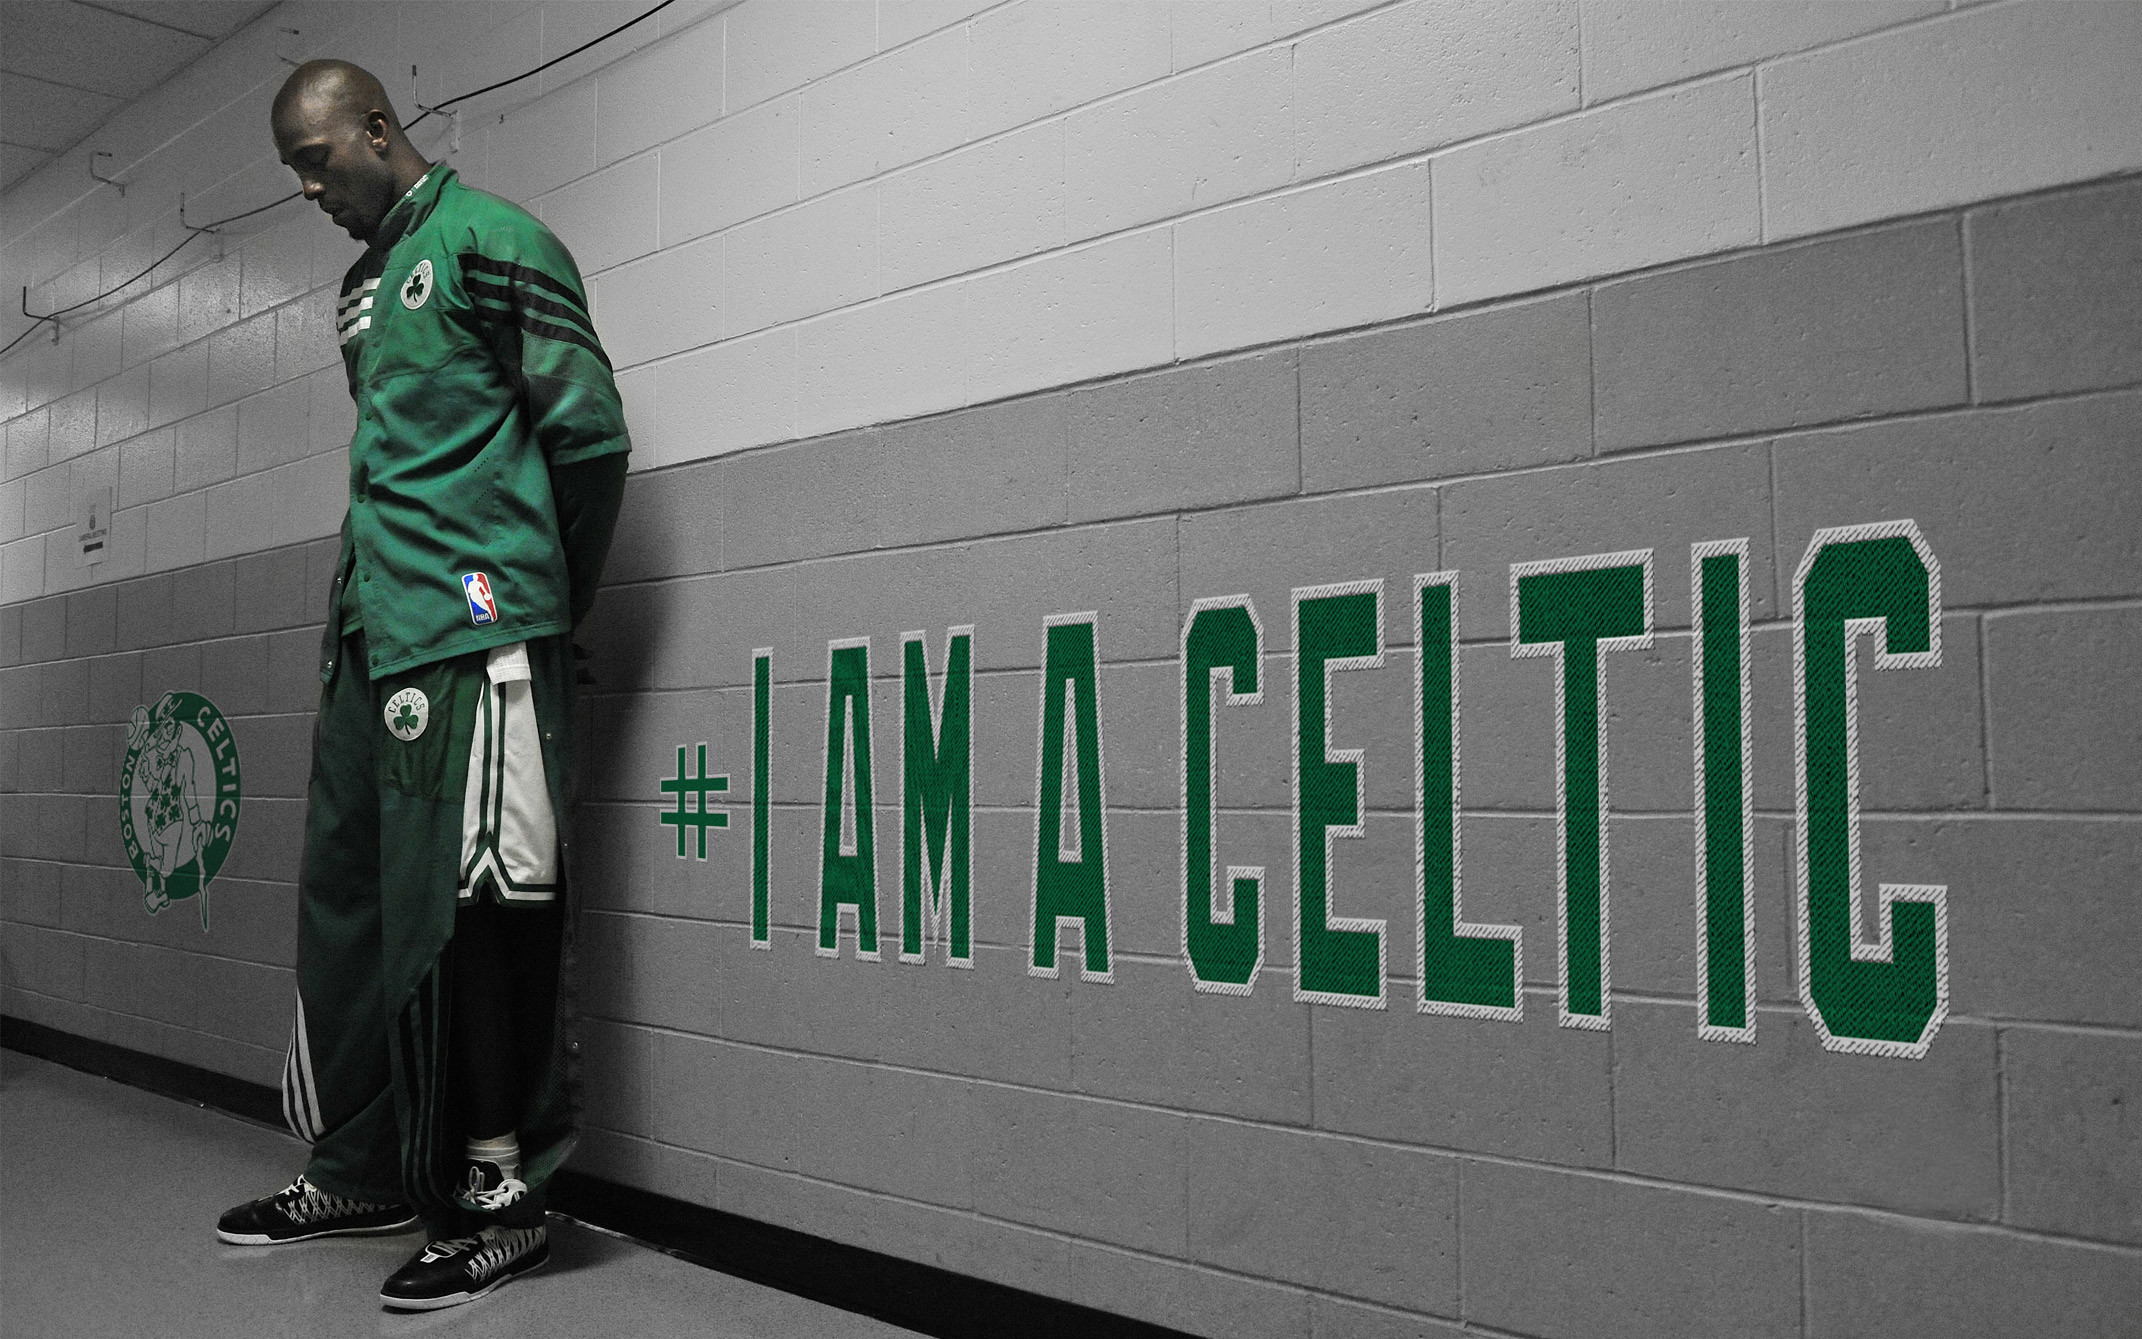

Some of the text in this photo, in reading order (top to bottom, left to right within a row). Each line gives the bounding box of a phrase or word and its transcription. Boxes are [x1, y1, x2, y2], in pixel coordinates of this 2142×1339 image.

[476, 613, 490, 621] NBA
[388, 692, 425, 713] CELTICS
[122, 706, 237, 859] BOSTON CELTICS
[816, 624, 976, 969] AM
[1028, 611, 1115, 983] A
[1180, 519, 1948, 1058] CELTIC
